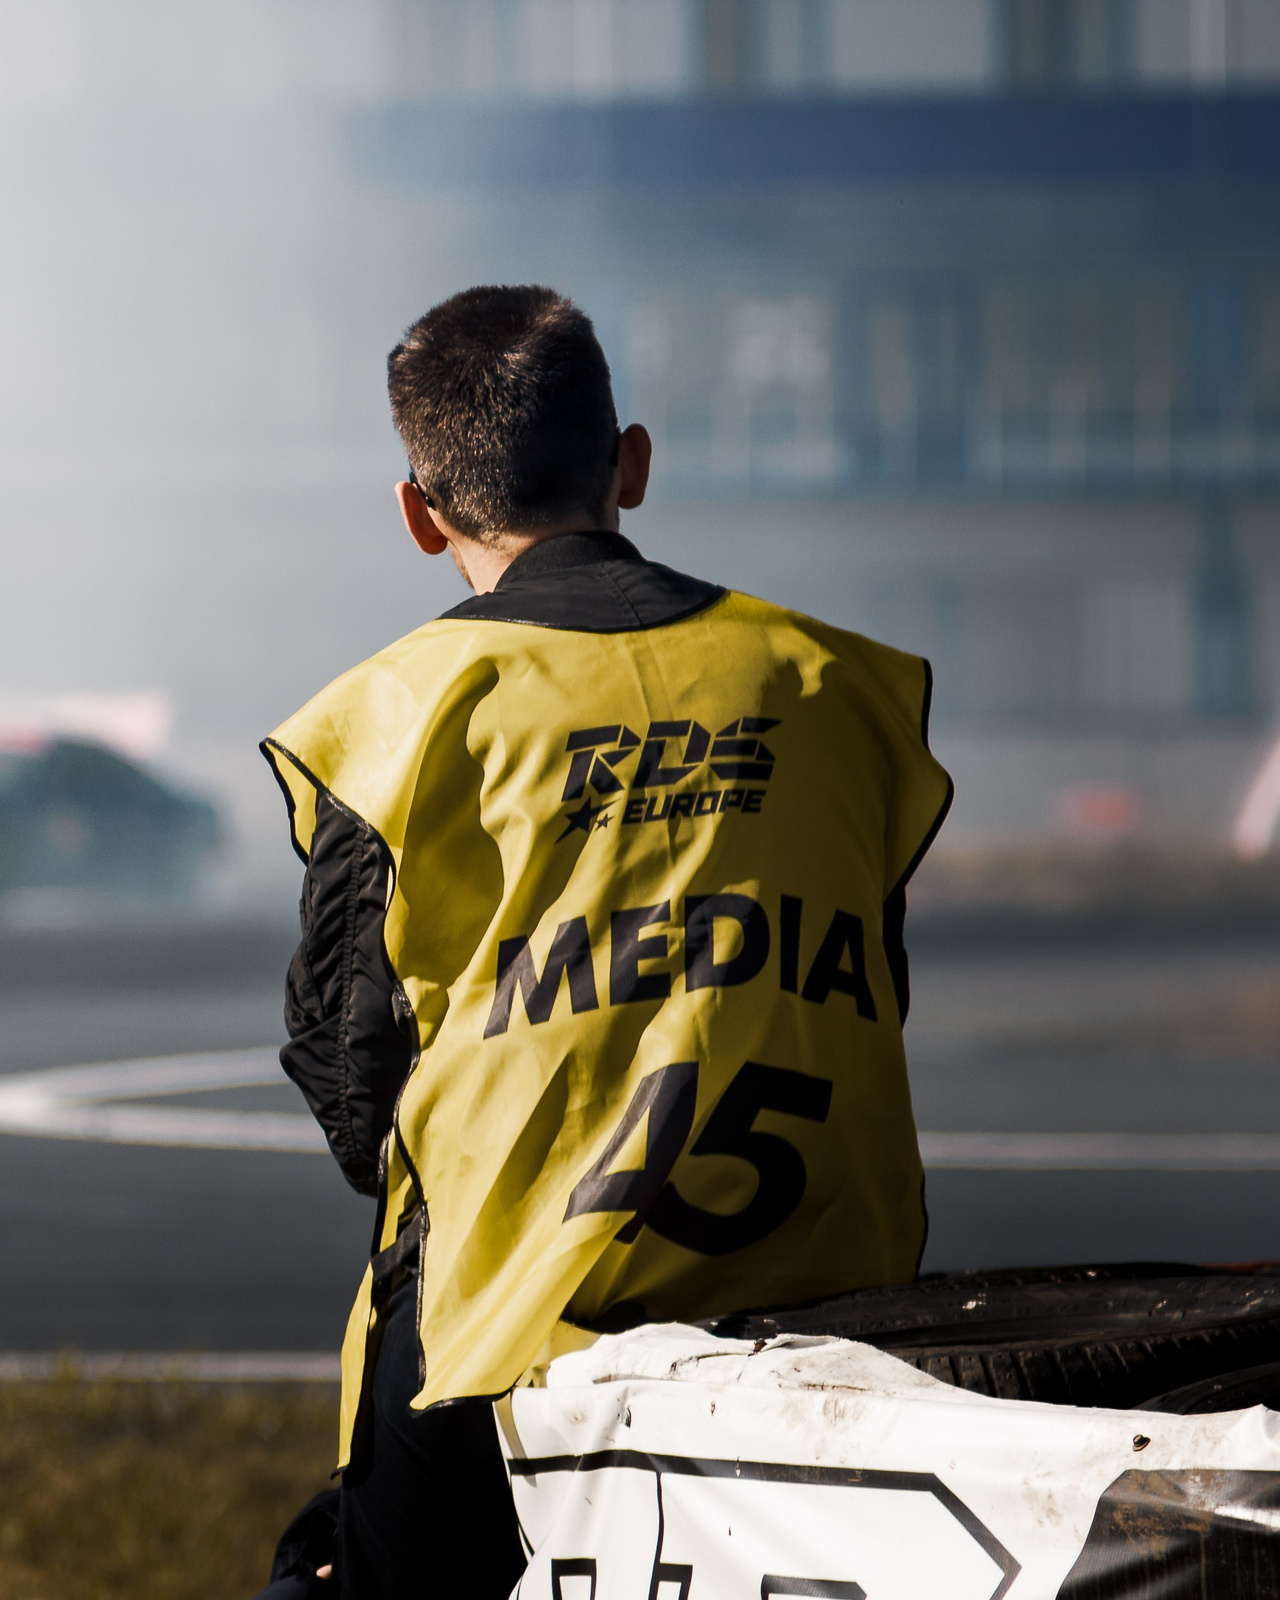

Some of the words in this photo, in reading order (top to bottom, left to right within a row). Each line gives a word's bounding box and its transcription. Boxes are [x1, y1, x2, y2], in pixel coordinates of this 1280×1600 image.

[561, 717, 782, 802] RDS
[622, 789, 766, 825] EUROPE
[483, 894, 877, 1041] MEDIA
[562, 1061, 833, 1256] 45
